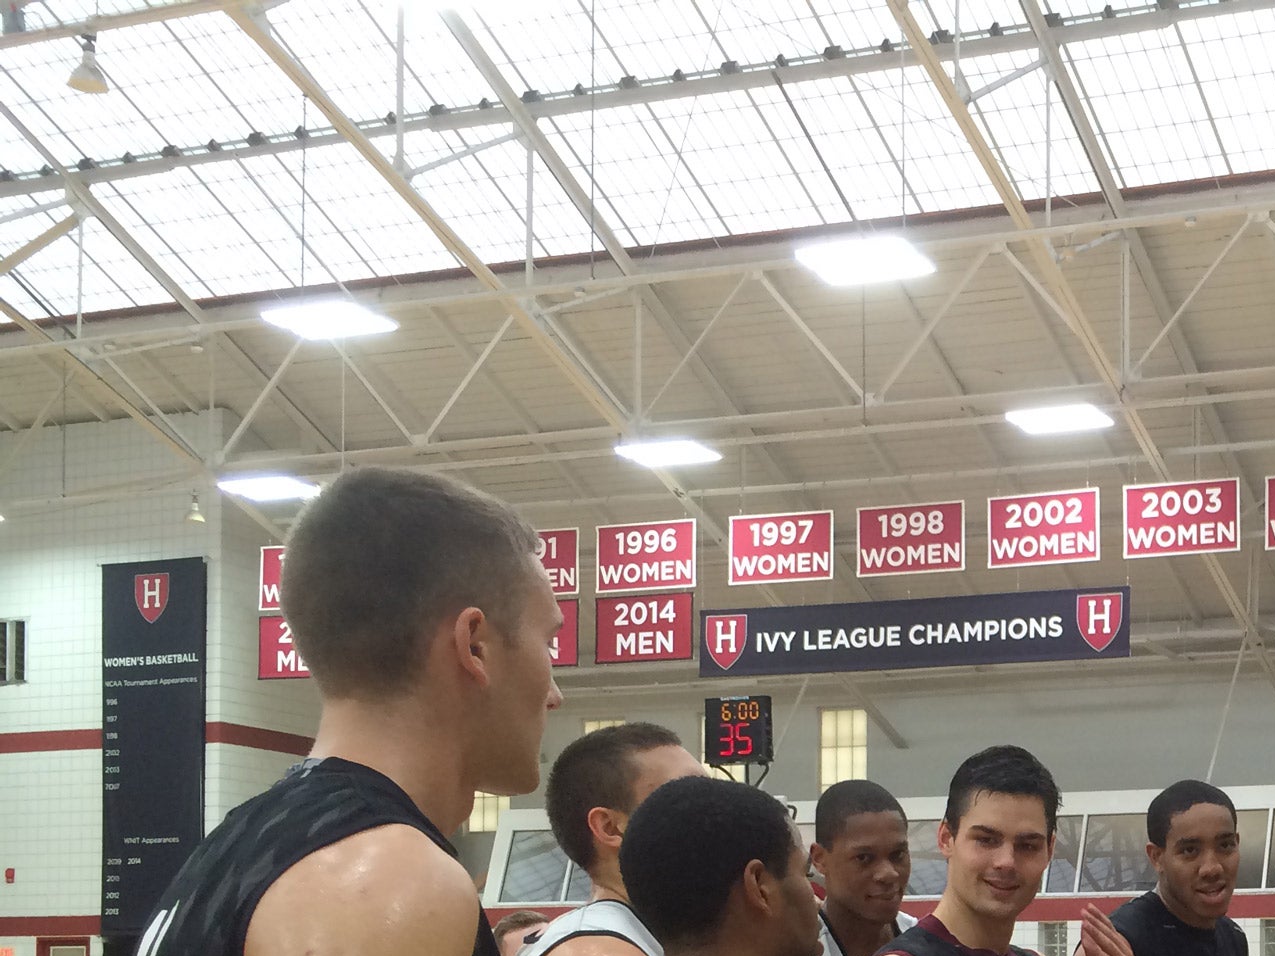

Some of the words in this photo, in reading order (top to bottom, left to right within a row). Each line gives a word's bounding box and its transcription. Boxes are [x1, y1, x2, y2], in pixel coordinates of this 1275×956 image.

[1005, 499, 1082, 528] 2002
[1142, 488, 1222, 518] 2003
[750, 520, 813, 546] 1997
[878, 511, 944, 537] 1998
[1128, 521, 1235, 549] WOMEN
[535, 537, 557, 559] 91
[615, 529, 677, 555] 1996
[993, 531, 1095, 559] WOMEN
[733, 552, 829, 576] WOMEN
[861, 543, 960, 568] WOMEN
[600, 559, 691, 584] WOMEN
[614, 601, 676, 626] 2014
[616, 630, 674, 656] MEN
[756, 631, 796, 653] IVY
[804, 626, 900, 651] LEAGUE
[909, 617, 1063, 645] CHAMPIONS
[146, 653, 198, 665] BASKETBALL
[124, 678, 158, 686] Tournament
[159, 677, 198, 685] Appearances
[720, 723, 752, 755] 35
